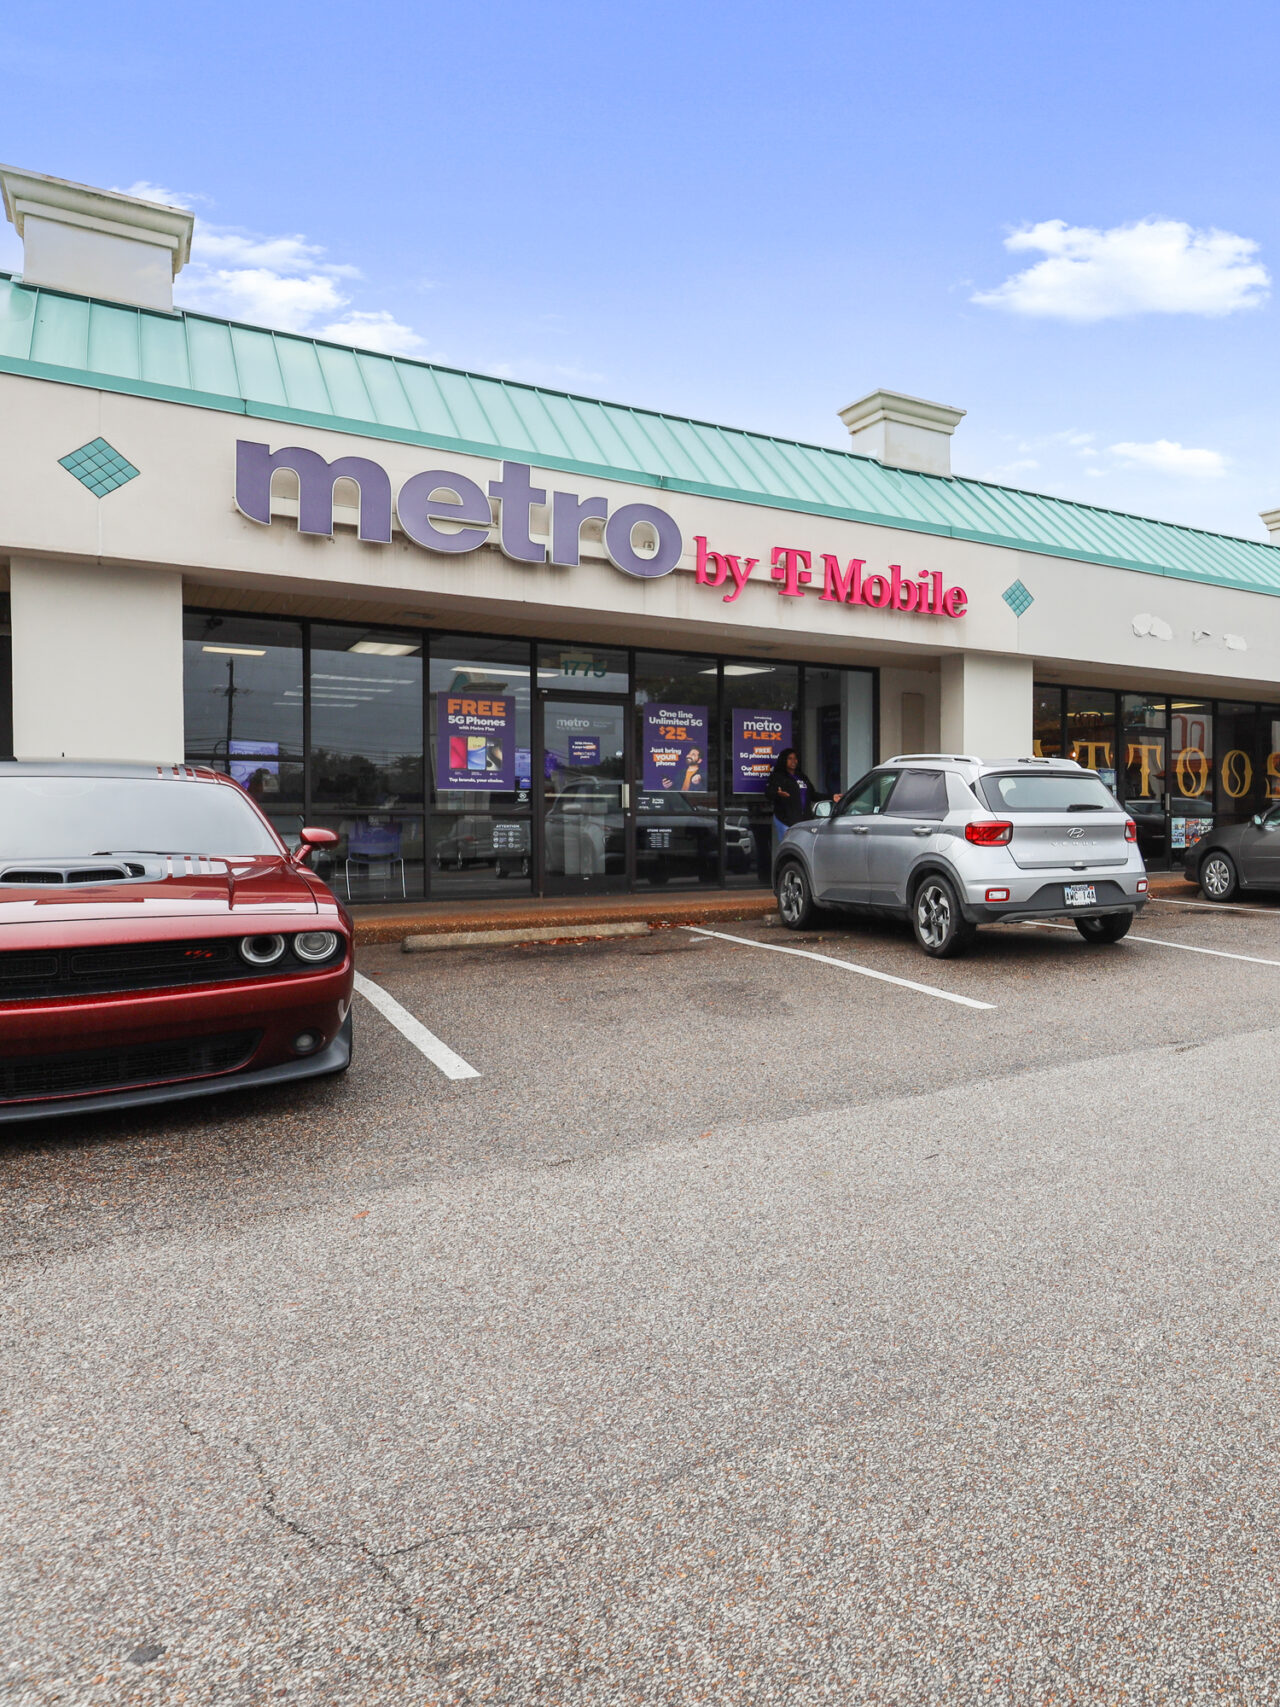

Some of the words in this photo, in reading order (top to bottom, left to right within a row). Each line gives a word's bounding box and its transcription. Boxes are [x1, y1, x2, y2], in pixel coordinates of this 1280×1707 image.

[233, 439, 683, 579] metro
[693, 536, 759, 602] by
[447, 698, 506, 717] FREE
[659, 710, 677, 718] One
[678, 710, 693, 718] line
[448, 715, 464, 724] 5G
[466, 716, 506, 726] Phones
[557, 718, 590, 728] metro
[649, 717, 689, 726] Unlimited
[690, 719, 703, 727] 5G
[743, 720, 782, 731] metro
[659, 726, 687, 741] $25
[743, 731, 782, 740] FLEX
[665, 747, 682, 755] bring
